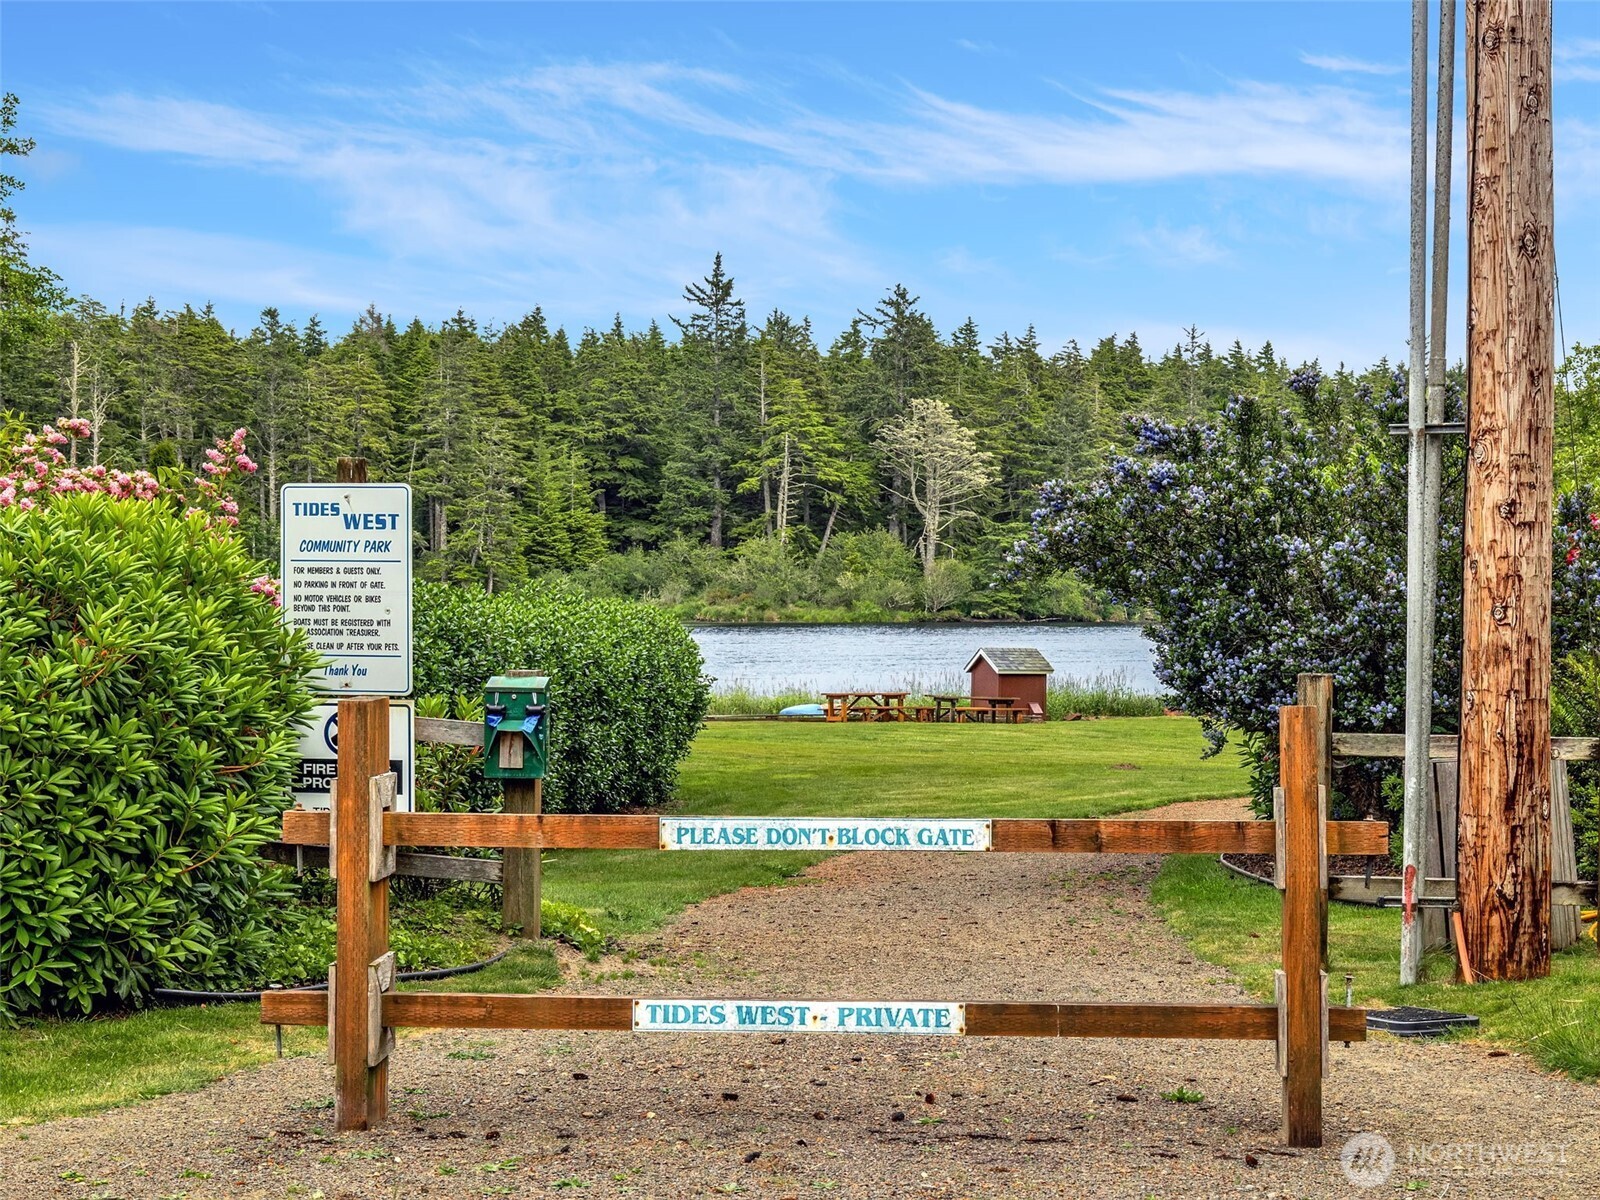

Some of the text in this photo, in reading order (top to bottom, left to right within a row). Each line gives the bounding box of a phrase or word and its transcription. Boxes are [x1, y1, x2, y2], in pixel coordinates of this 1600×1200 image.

[292, 503, 400, 530] TIDES WEST
[300, 540, 392, 553] COMMUNITY PARK
[307, 567, 334, 575] MEMBERS
[336, 567, 341, 575] &
[343, 567, 364, 575] GUESTS
[366, 567, 382, 575] ONLY.
[304, 581, 328, 589] PARKING
[330, 581, 337, 589] IN
[338, 581, 357, 589] FRONT
[360, 581, 368, 589] OF
[304, 595, 324, 603] MOTOR
[326, 595, 351, 603] VEHICLES
[353, 595, 362, 603] OR
[365, 595, 382, 603] BIKES
[293, 604, 316, 612] BEYOND
[340, 619, 374, 627] REGISTERED
[376, 619, 391, 627] WITH
[346, 629, 380, 637] TREASURER.
[316, 642, 334, 650] CLEAN
[366, 643, 382, 651] YOUR
[384, 643, 400, 651] PETS.
[324, 664, 368, 676] Thank You
[304, 763, 338, 775] FIRE
[676, 826, 975, 847] PLEASE DON'T BLOCK GATE
[646, 1004, 726, 1026] TIDES
[736, 1005, 811, 1026] WEST
[837, 1007, 951, 1028] PRIVATE
